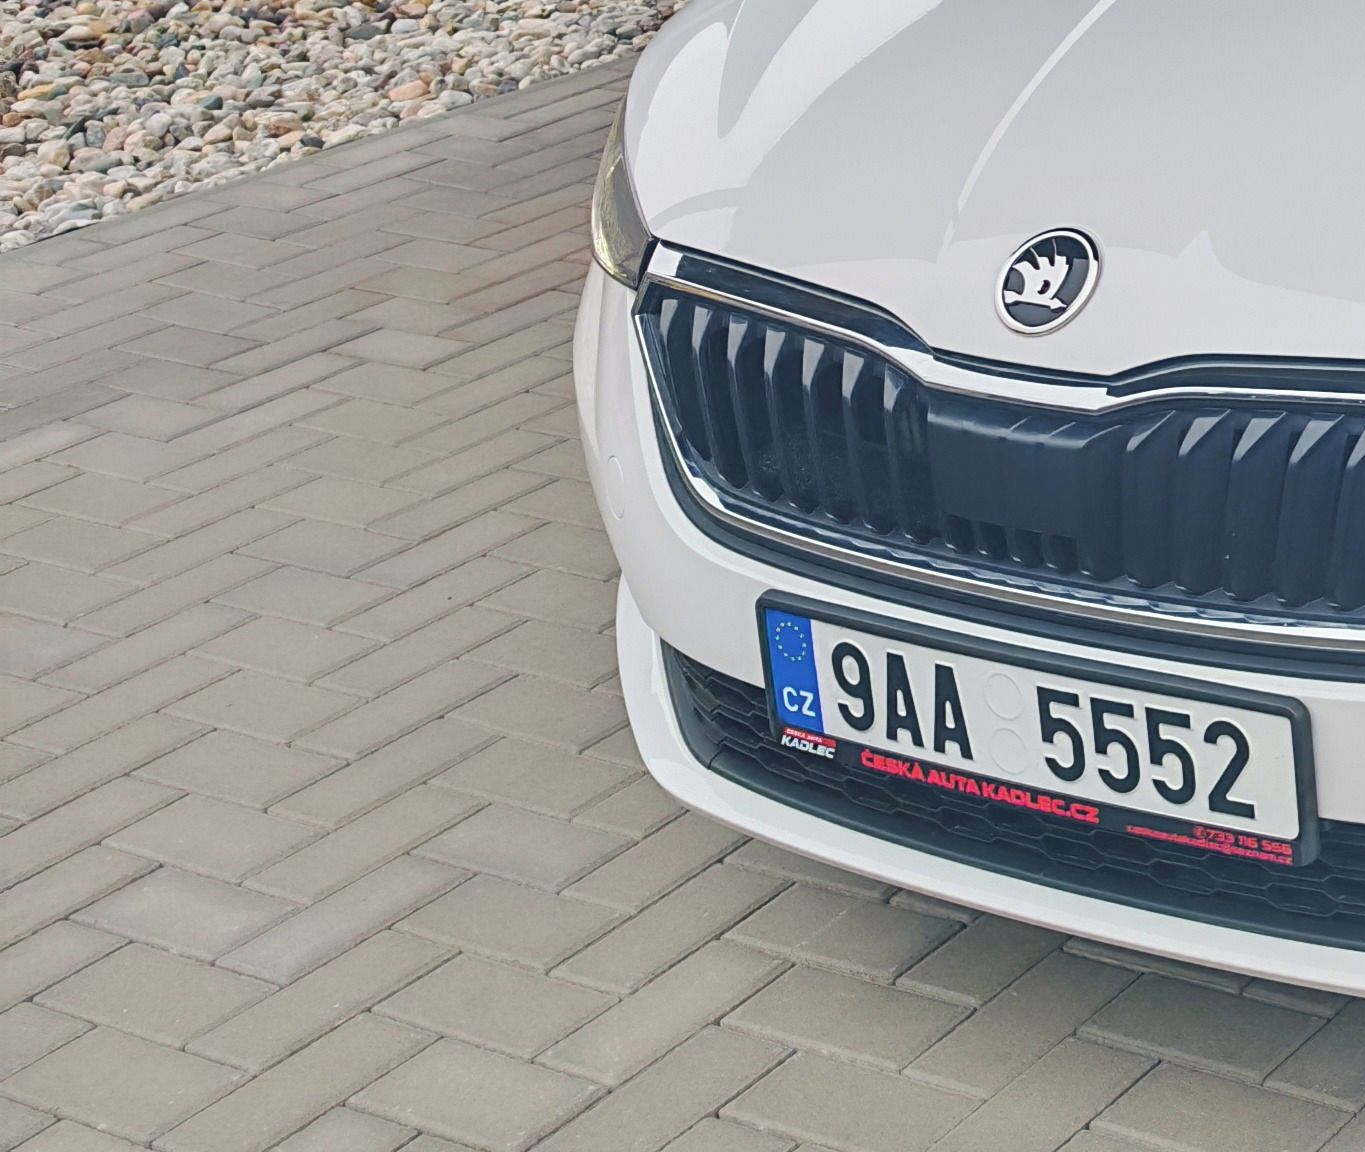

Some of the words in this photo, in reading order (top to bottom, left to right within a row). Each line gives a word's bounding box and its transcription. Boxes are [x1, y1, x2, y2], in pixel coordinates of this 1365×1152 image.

[782, 686, 816, 718] CZ
[780, 734, 836, 759] KADLEC
[830, 641, 975, 761] 9AA
[1035, 684, 1257, 820] 5552
[860, 748, 927, 783] ČESKÁ
[927, 769, 981, 797] AUTA
[981, 782, 1100, 824] KADLEC.CZ
